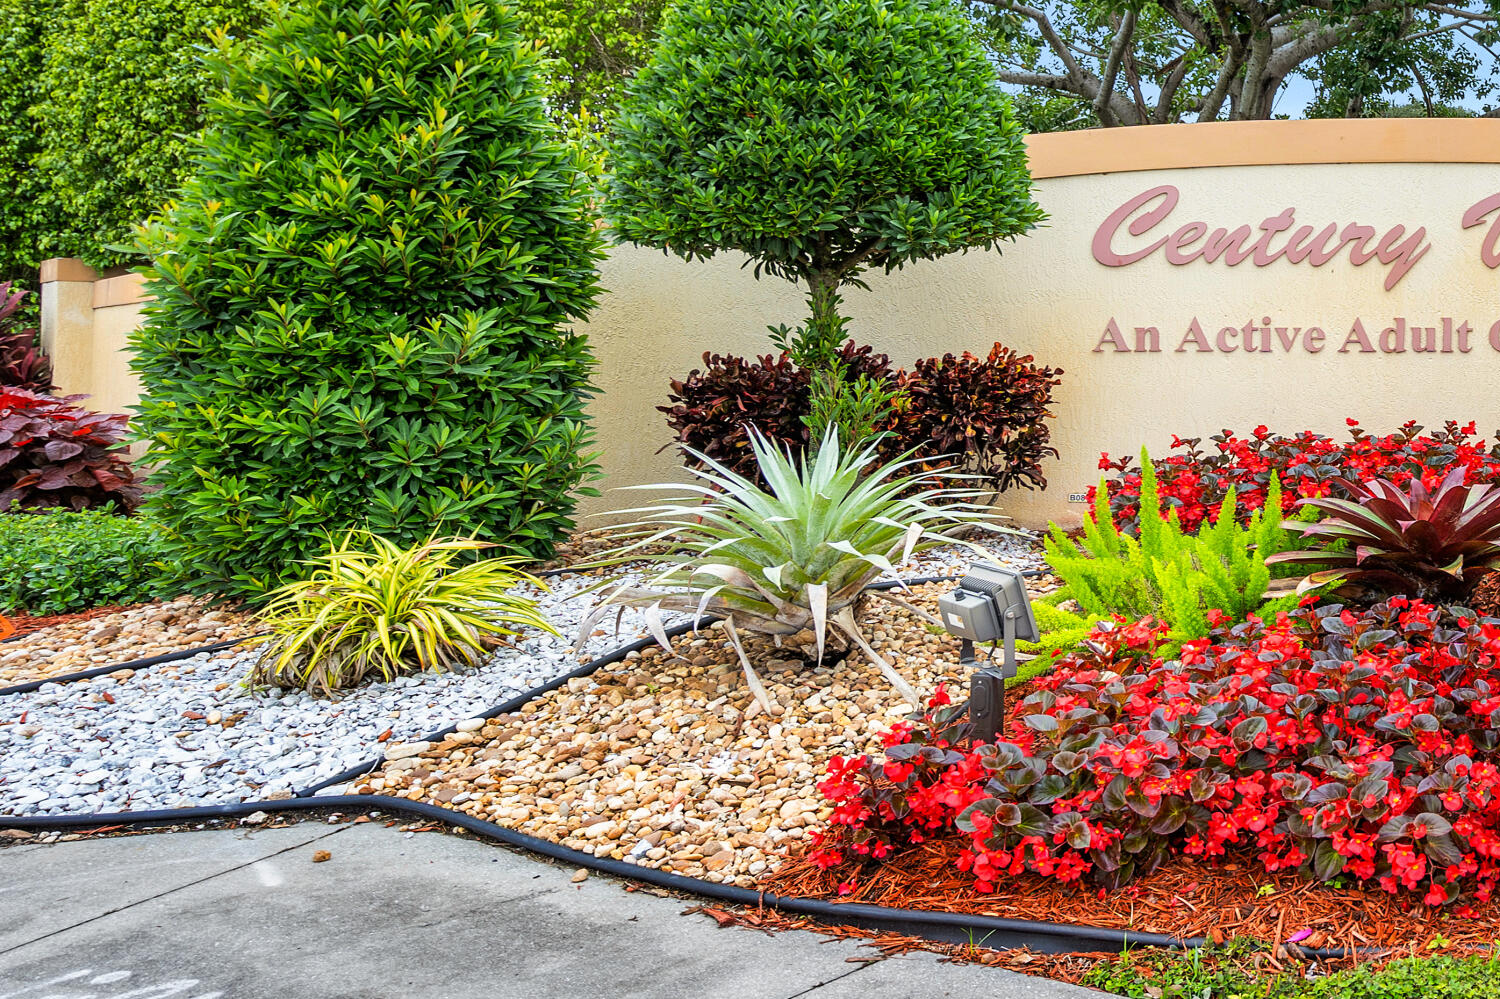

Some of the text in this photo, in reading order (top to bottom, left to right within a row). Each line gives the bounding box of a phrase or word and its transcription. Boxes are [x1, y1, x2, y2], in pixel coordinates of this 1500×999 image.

[1091, 185, 1431, 292] Century
[1092, 317, 1162, 353] An
[1174, 316, 1326, 354] Active
[1337, 317, 1473, 353] Adult
